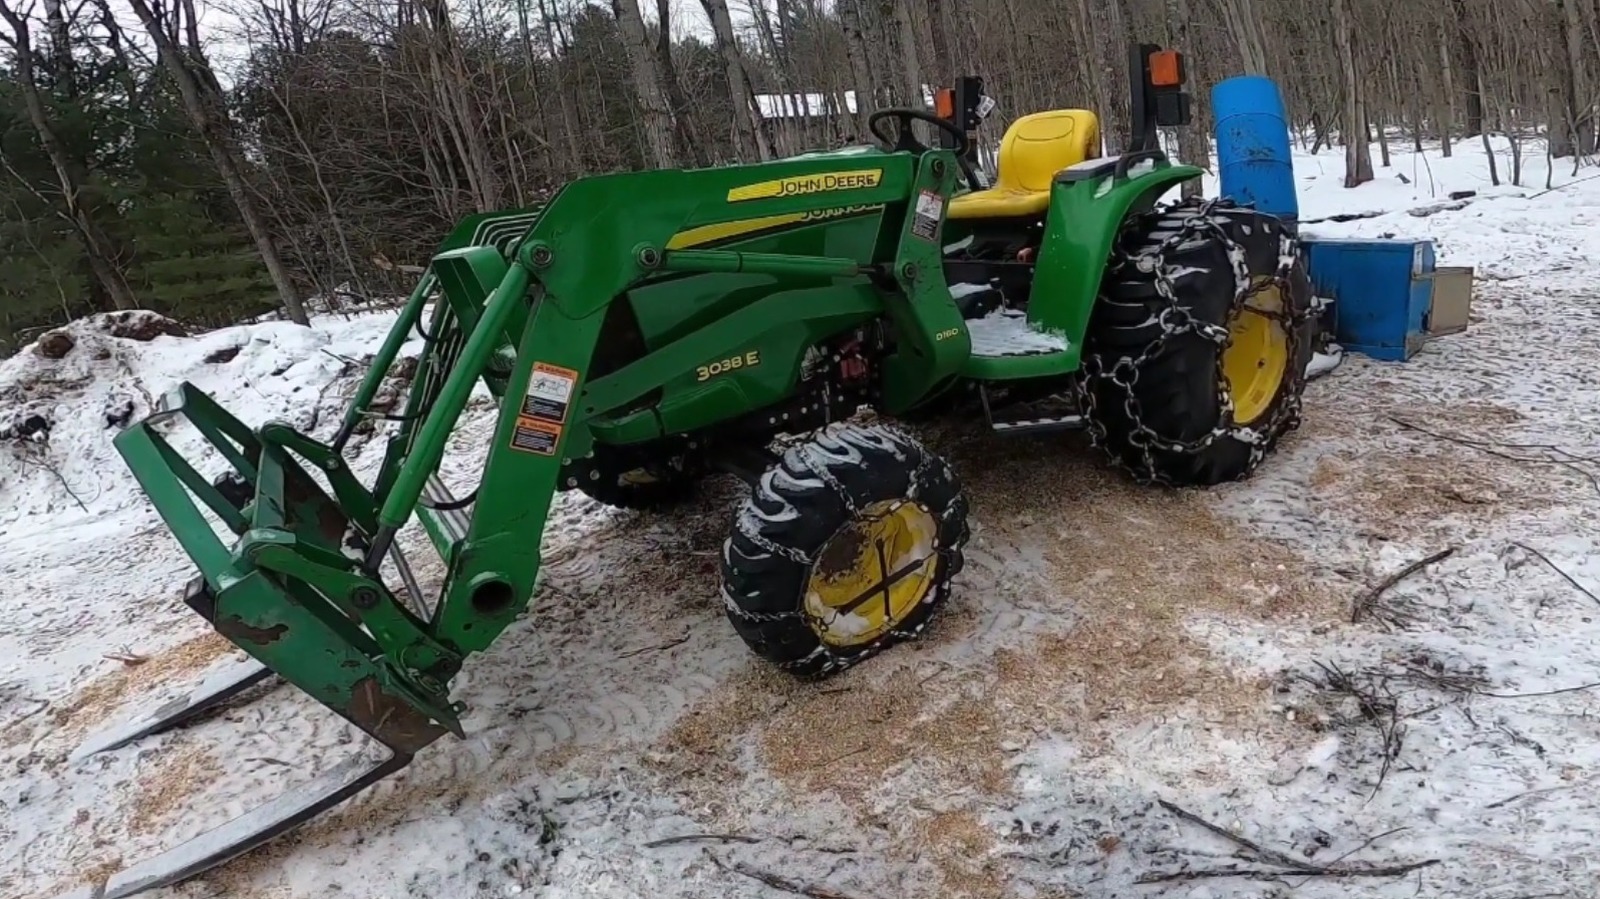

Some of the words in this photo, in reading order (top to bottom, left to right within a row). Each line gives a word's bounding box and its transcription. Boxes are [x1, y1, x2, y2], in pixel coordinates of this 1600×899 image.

[776, 179, 821, 195] JOHN
[824, 174, 875, 189] DEERE
[696, 356, 743, 381] 3038
[746, 350, 760, 366] E
